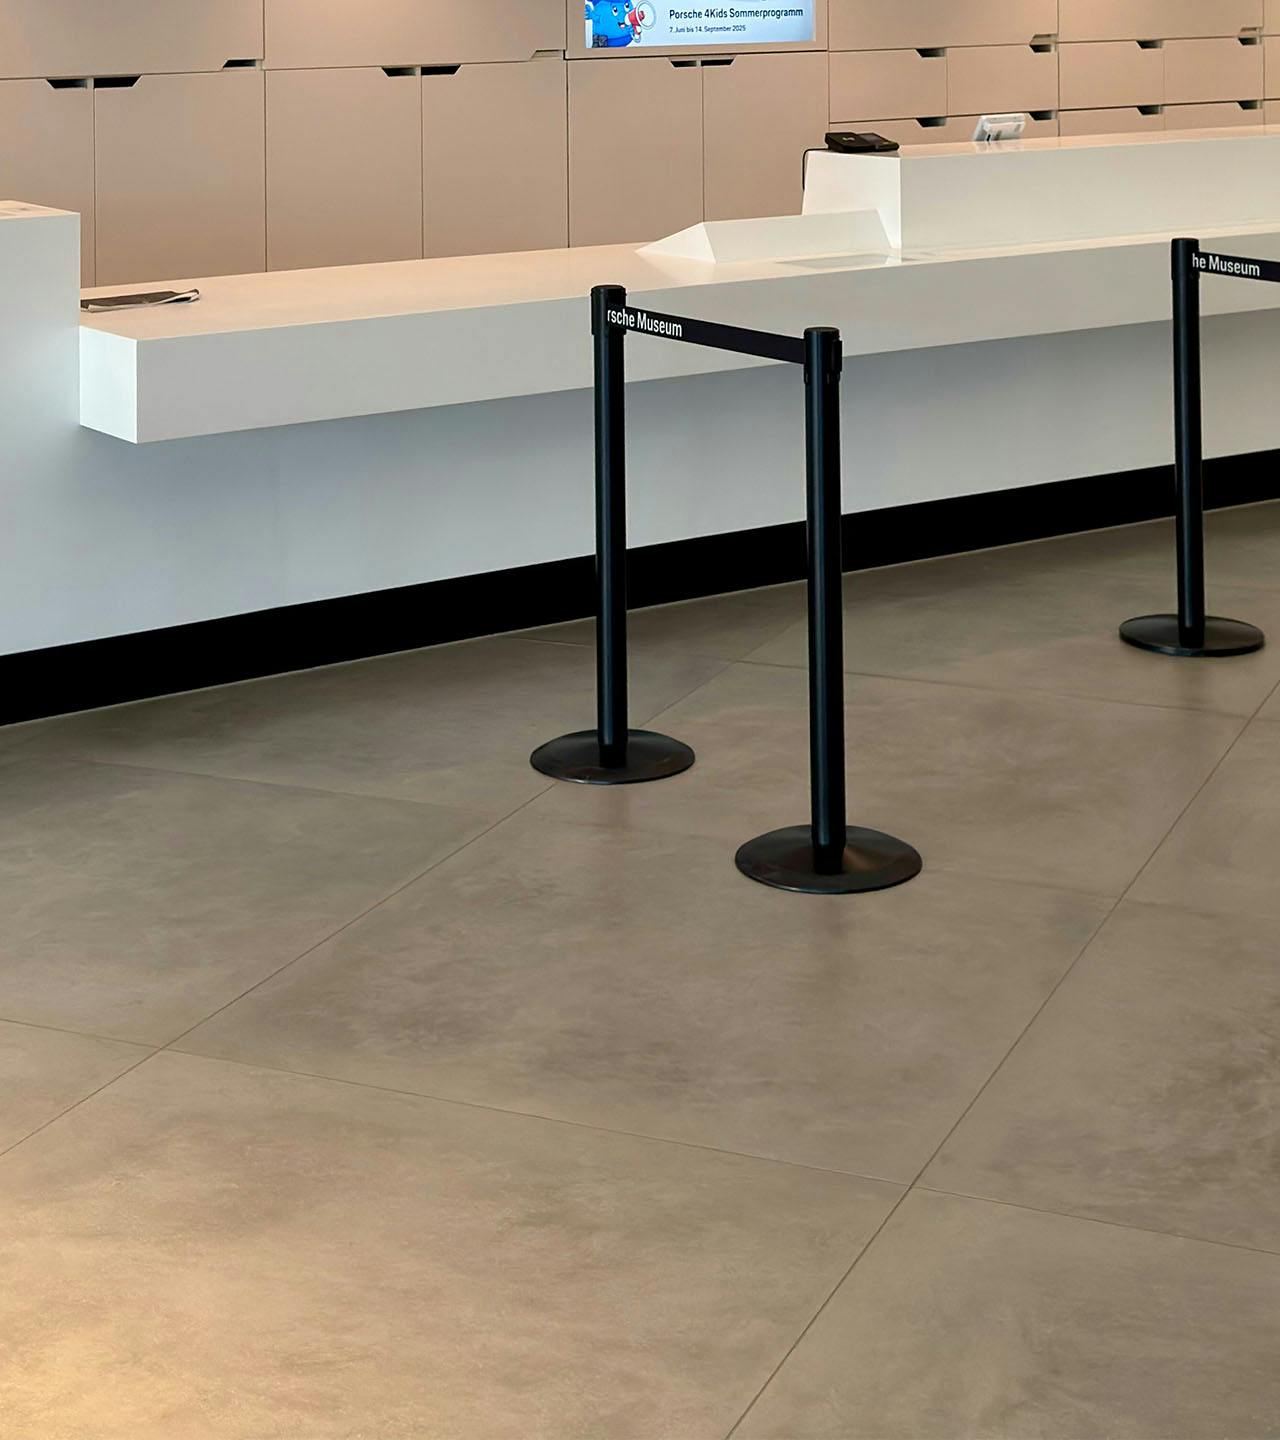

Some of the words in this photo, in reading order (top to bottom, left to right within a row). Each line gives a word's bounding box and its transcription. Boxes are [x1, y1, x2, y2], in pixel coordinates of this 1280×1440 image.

[669, 8, 703, 20] Porsche
[704, 8, 728, 19] 4Kids
[729, 8, 804, 20] Sommerprogramm
[704, 25, 732, 34] September
[1192, 252, 1206, 269] he
[1208, 254, 1260, 277] Museum
[607, 308, 635, 328] rsche
[636, 311, 683, 338] Museum
